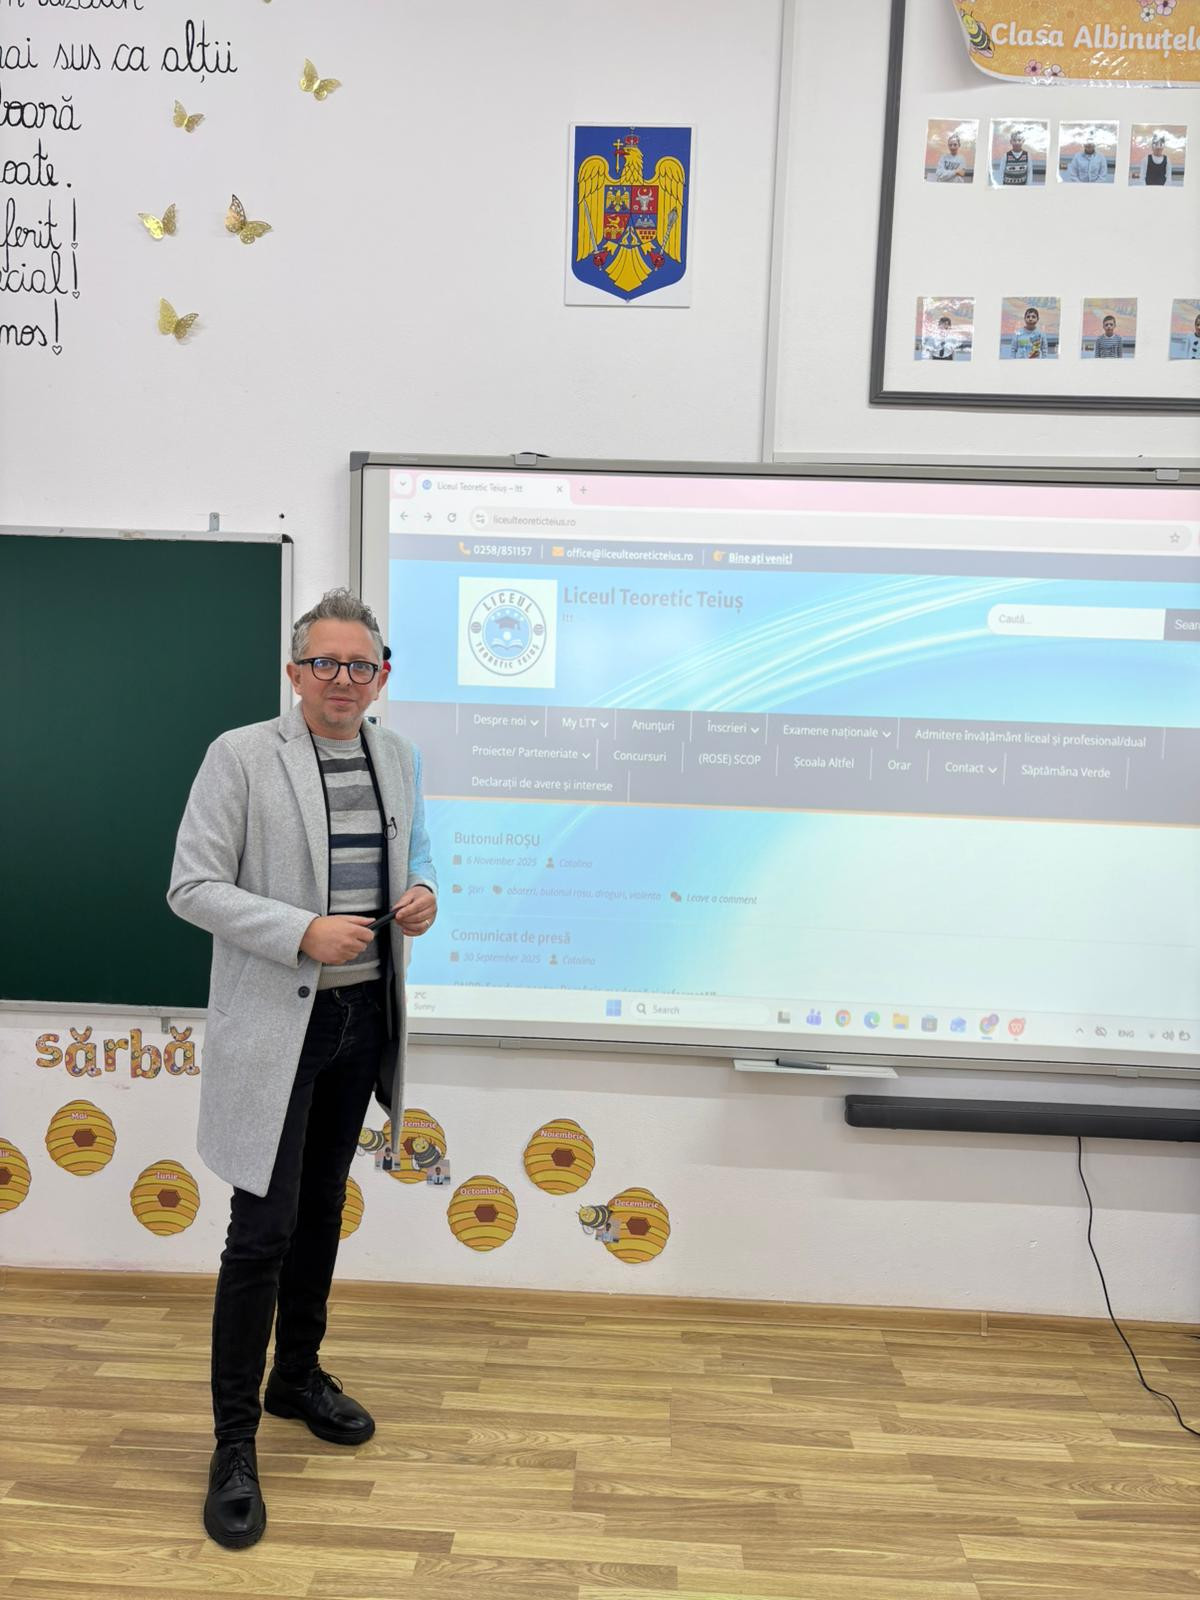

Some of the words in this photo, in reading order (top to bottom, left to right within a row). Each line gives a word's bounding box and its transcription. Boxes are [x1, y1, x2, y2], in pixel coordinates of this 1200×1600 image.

[990, 22, 1064, 47] Clasa
[53, 43, 101, 70] sus
[111, 43, 150, 71] ca
[161, 19, 238, 83] alții
[0, 250, 80, 299] cial!
[473, 544, 533, 557] 0258/851157
[566, 548, 694, 561] office@liceulteoreticteius.ro
[728, 552, 751, 564] Bine
[482, 592, 532, 613] LICEUL
[563, 586, 615, 605] Liceul
[619, 588, 693, 608] Teoretic
[696, 590, 744, 614] Teiuș
[473, 714, 509, 729] Despre
[511, 715, 527, 726] noi
[561, 717, 578, 730] My
[579, 718, 597, 729] LTT
[632, 720, 675, 733] Anunțuri
[707, 719, 748, 734] Înscrieri
[783, 724, 829, 737] Examene
[831, 726, 879, 739] naționale
[914, 728, 963, 741] Admitere
[1024, 731, 1050, 743] liceal
[1051, 732, 1061, 747] și
[1063, 733, 1147, 748] profesional/dual
[518, 746, 578, 759] Parteneriate
[613, 750, 667, 763] Concursuri
[698, 753, 732, 767] (ROSE)
[734, 754, 761, 765] SCOP
[793, 756, 826, 769] Școala
[828, 757, 854, 769] Altfel
[887, 759, 912, 771] Orar
[944, 761, 984, 773] Contact
[1021, 764, 1078, 778] Săptămâna
[1080, 766, 1111, 778] Verde
[471, 776, 517, 789] Declarații
[519, 777, 532, 788] de
[533, 780, 561, 790] avere
[573, 780, 613, 791] interese
[454, 831, 503, 846] Butonul
[505, 833, 541, 848] ROȘU
[472, 856, 515, 866] November
[517, 857, 537, 867] 2025
[686, 893, 710, 903] Leave
[719, 895, 758, 905] comment
[451, 928, 518, 943] Comunicat
[520, 930, 535, 943] de
[538, 931, 571, 946] presă
[475, 952, 519, 964] September
[520, 954, 541, 964] 2025
[652, 1005, 680, 1015] Search
[1118, 1029, 1135, 1038] ENG
[35, 1025, 200, 1079] sărbă
[70, 1111, 88, 1120] Mai
[540, 1129, 585, 1140] Noiembrie
[460, 1187, 505, 1196] Octombrie
[614, 1199, 659, 1209] Decembrie
